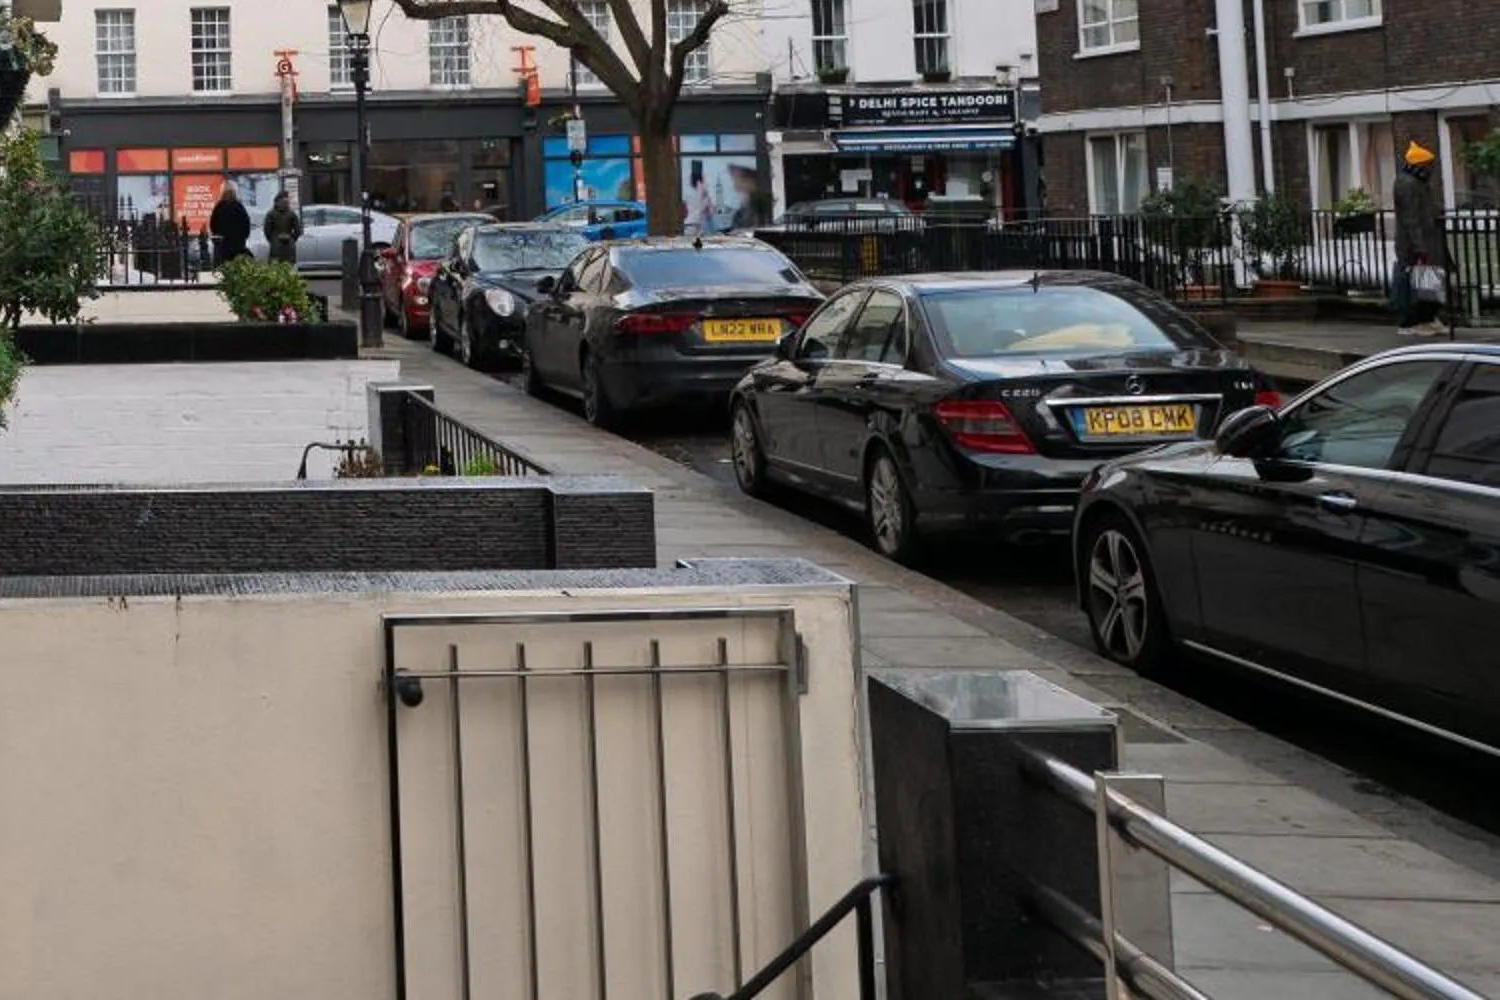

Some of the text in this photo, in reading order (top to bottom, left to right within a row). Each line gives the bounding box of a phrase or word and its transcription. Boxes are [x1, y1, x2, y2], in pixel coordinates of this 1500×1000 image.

[859, 97, 897, 109] DELHI
[901, 96, 937, 108] SPICE
[1088, 406, 1191, 430] KP08 CMK
